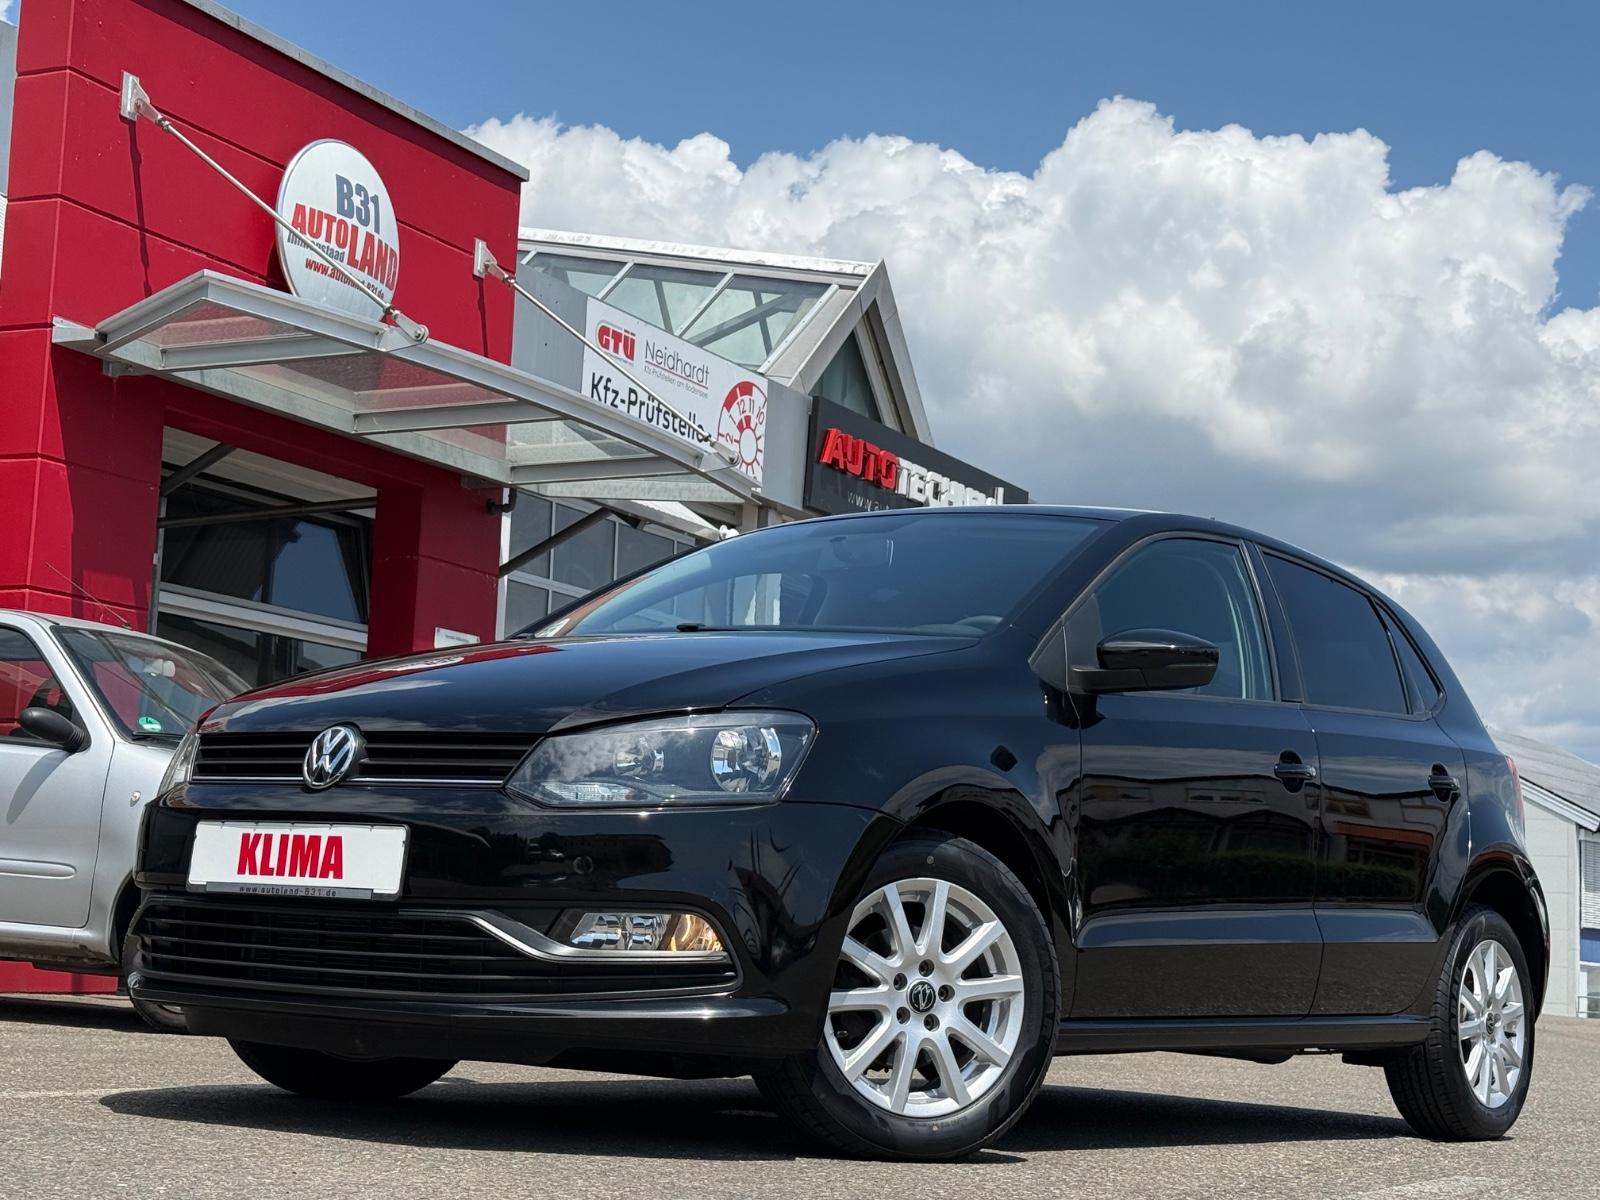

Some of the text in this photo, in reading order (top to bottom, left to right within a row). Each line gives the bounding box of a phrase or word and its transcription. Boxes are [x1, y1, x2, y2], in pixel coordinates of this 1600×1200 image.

[336, 174, 380, 235] B31
[291, 202, 398, 292] AUTOLAND
[597, 325, 636, 361] GTÜ
[645, 339, 709, 386] Neidhardt
[236, 832, 344, 880] KLIMA
